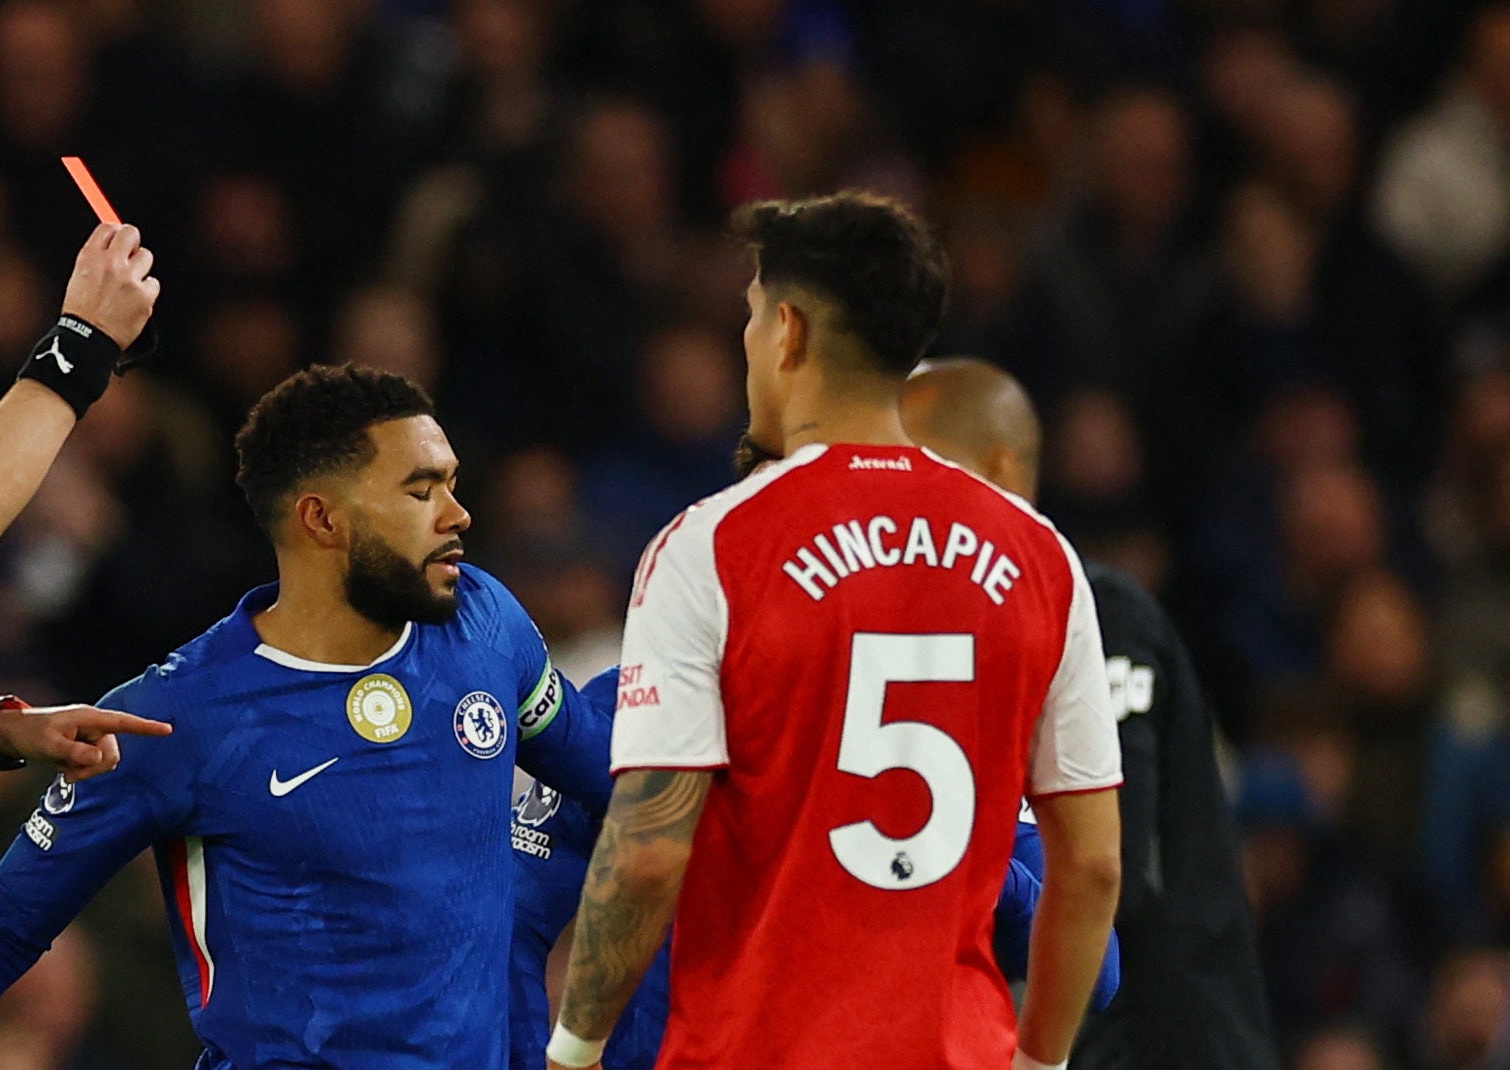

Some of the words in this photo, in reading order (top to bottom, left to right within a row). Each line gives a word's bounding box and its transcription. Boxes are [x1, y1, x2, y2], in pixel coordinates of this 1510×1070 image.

[848, 456, 912, 471] Arsenal
[782, 516, 1022, 605] HINCAPIE
[352, 690, 365, 723] WORLD
[364, 680, 406, 711] CHAMPIONS
[458, 694, 491, 716] CHELSEA
[374, 724, 400, 739] FIFA
[828, 632, 976, 891] 5
[515, 825, 550, 846] room
